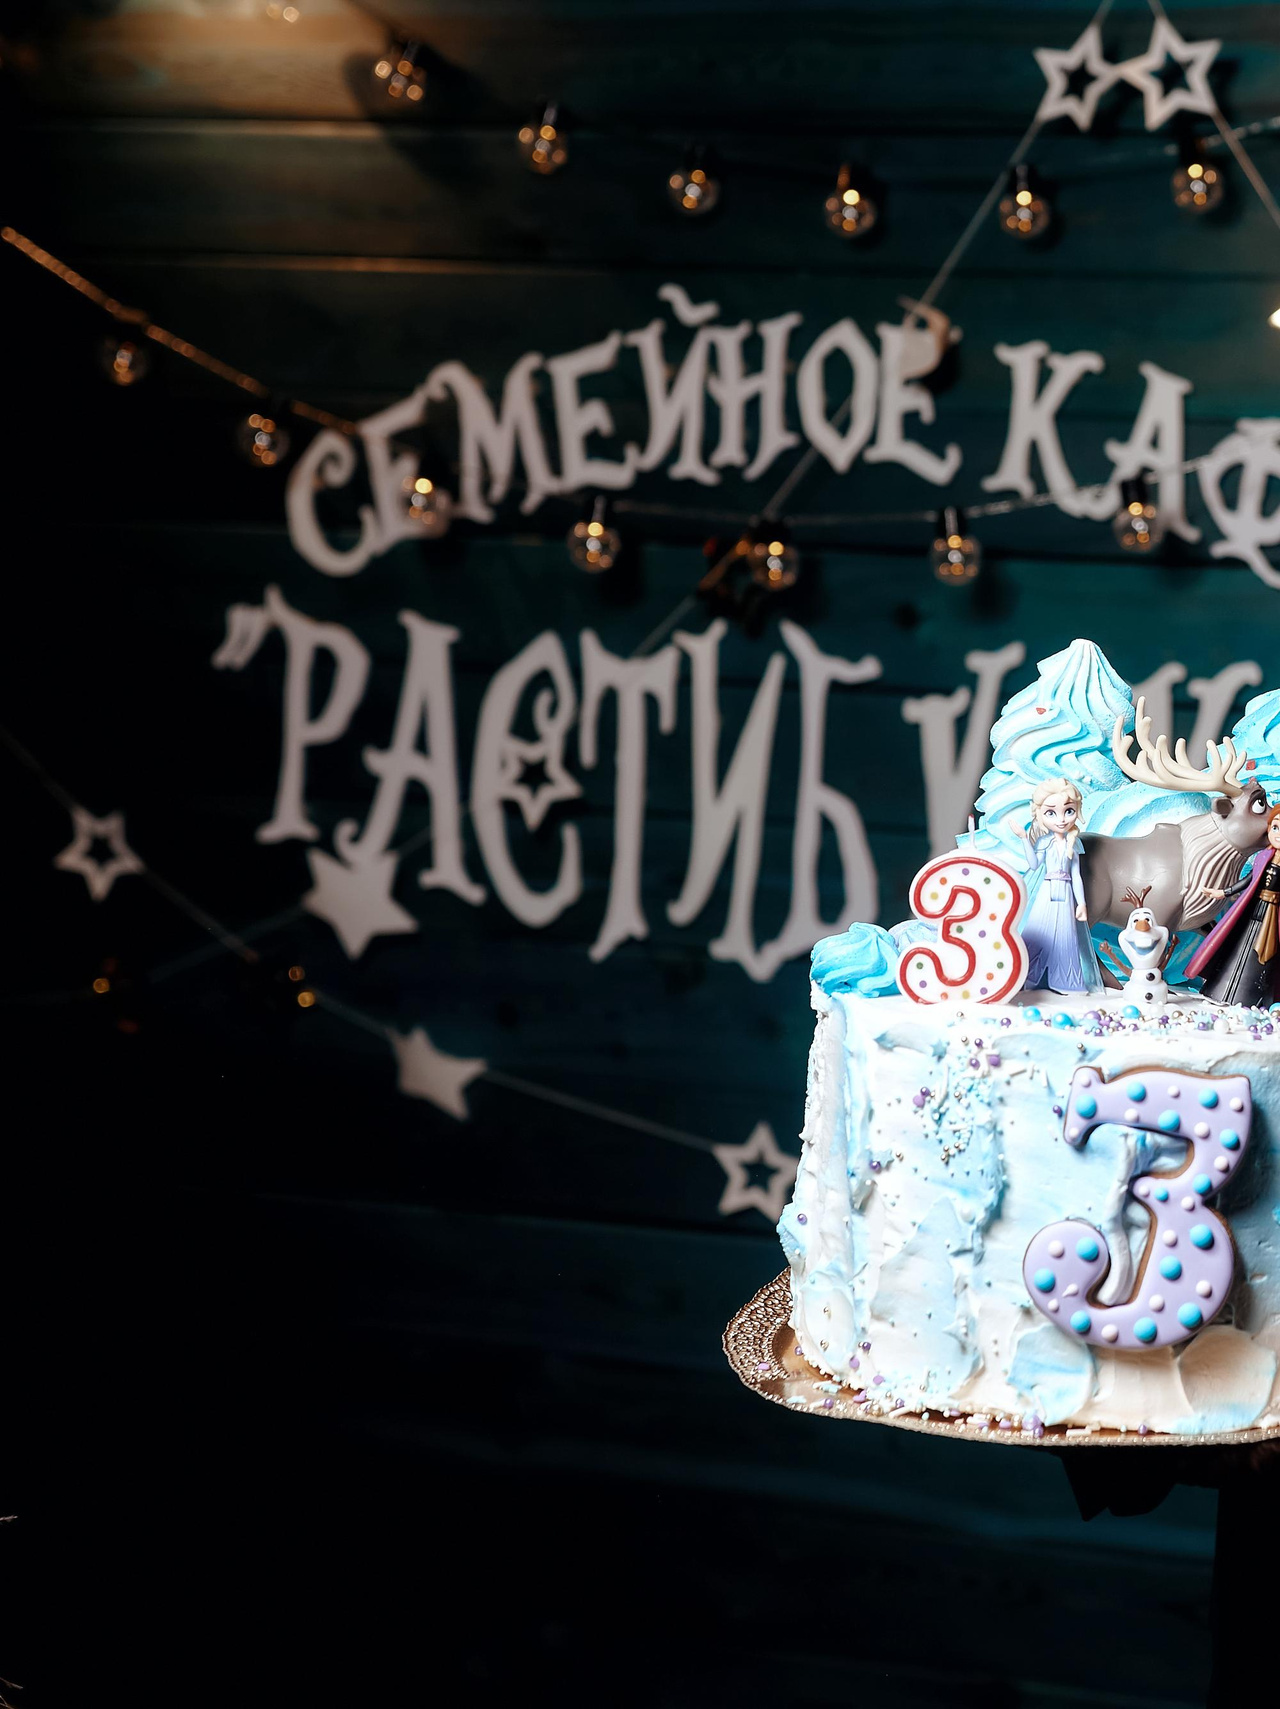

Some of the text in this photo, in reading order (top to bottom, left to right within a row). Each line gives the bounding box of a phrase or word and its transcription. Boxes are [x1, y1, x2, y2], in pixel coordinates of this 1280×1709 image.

[285, 283, 962, 578] СЕМЕЙНОЕ
[897, 855, 1029, 1004] 3
[1023, 1065, 1254, 1352] 3
